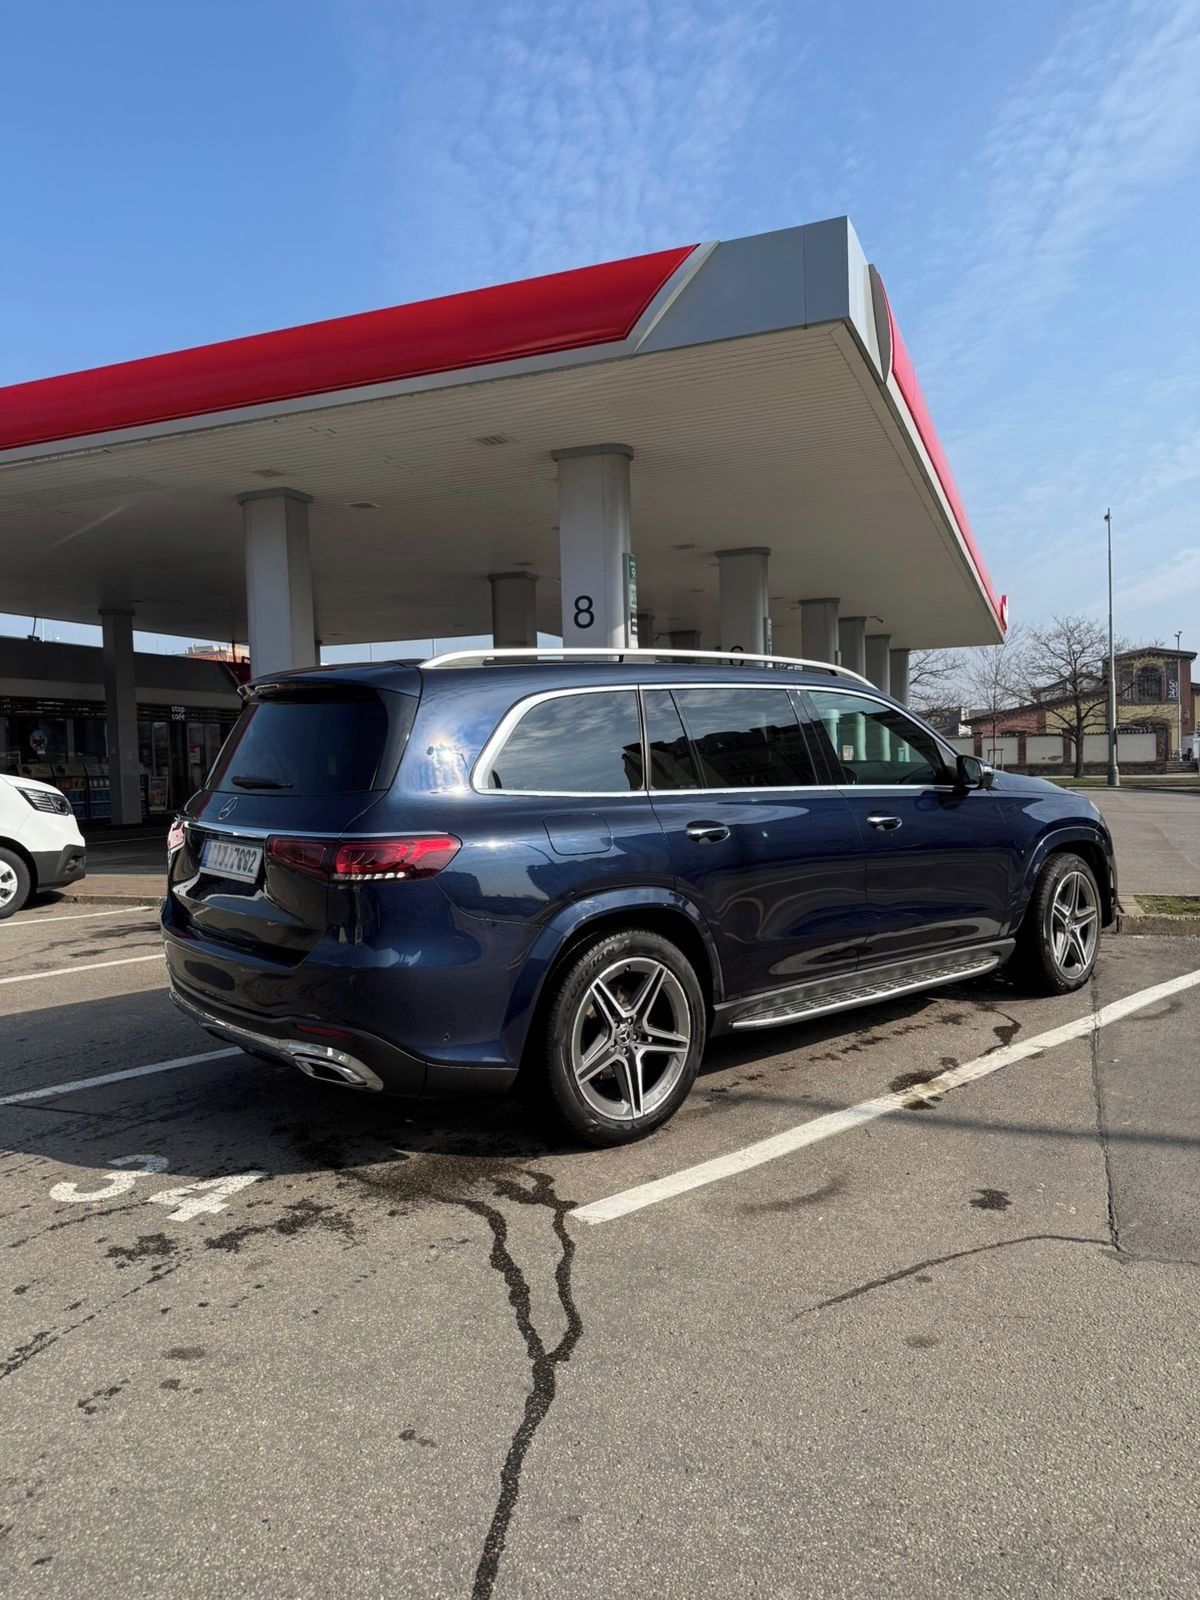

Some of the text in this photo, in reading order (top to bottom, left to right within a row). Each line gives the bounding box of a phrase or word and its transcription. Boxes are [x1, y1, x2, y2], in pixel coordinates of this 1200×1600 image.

[573, 595, 595, 630] 8
[171, 705, 186, 713] stop
[49, 1154, 270, 1222] 34
